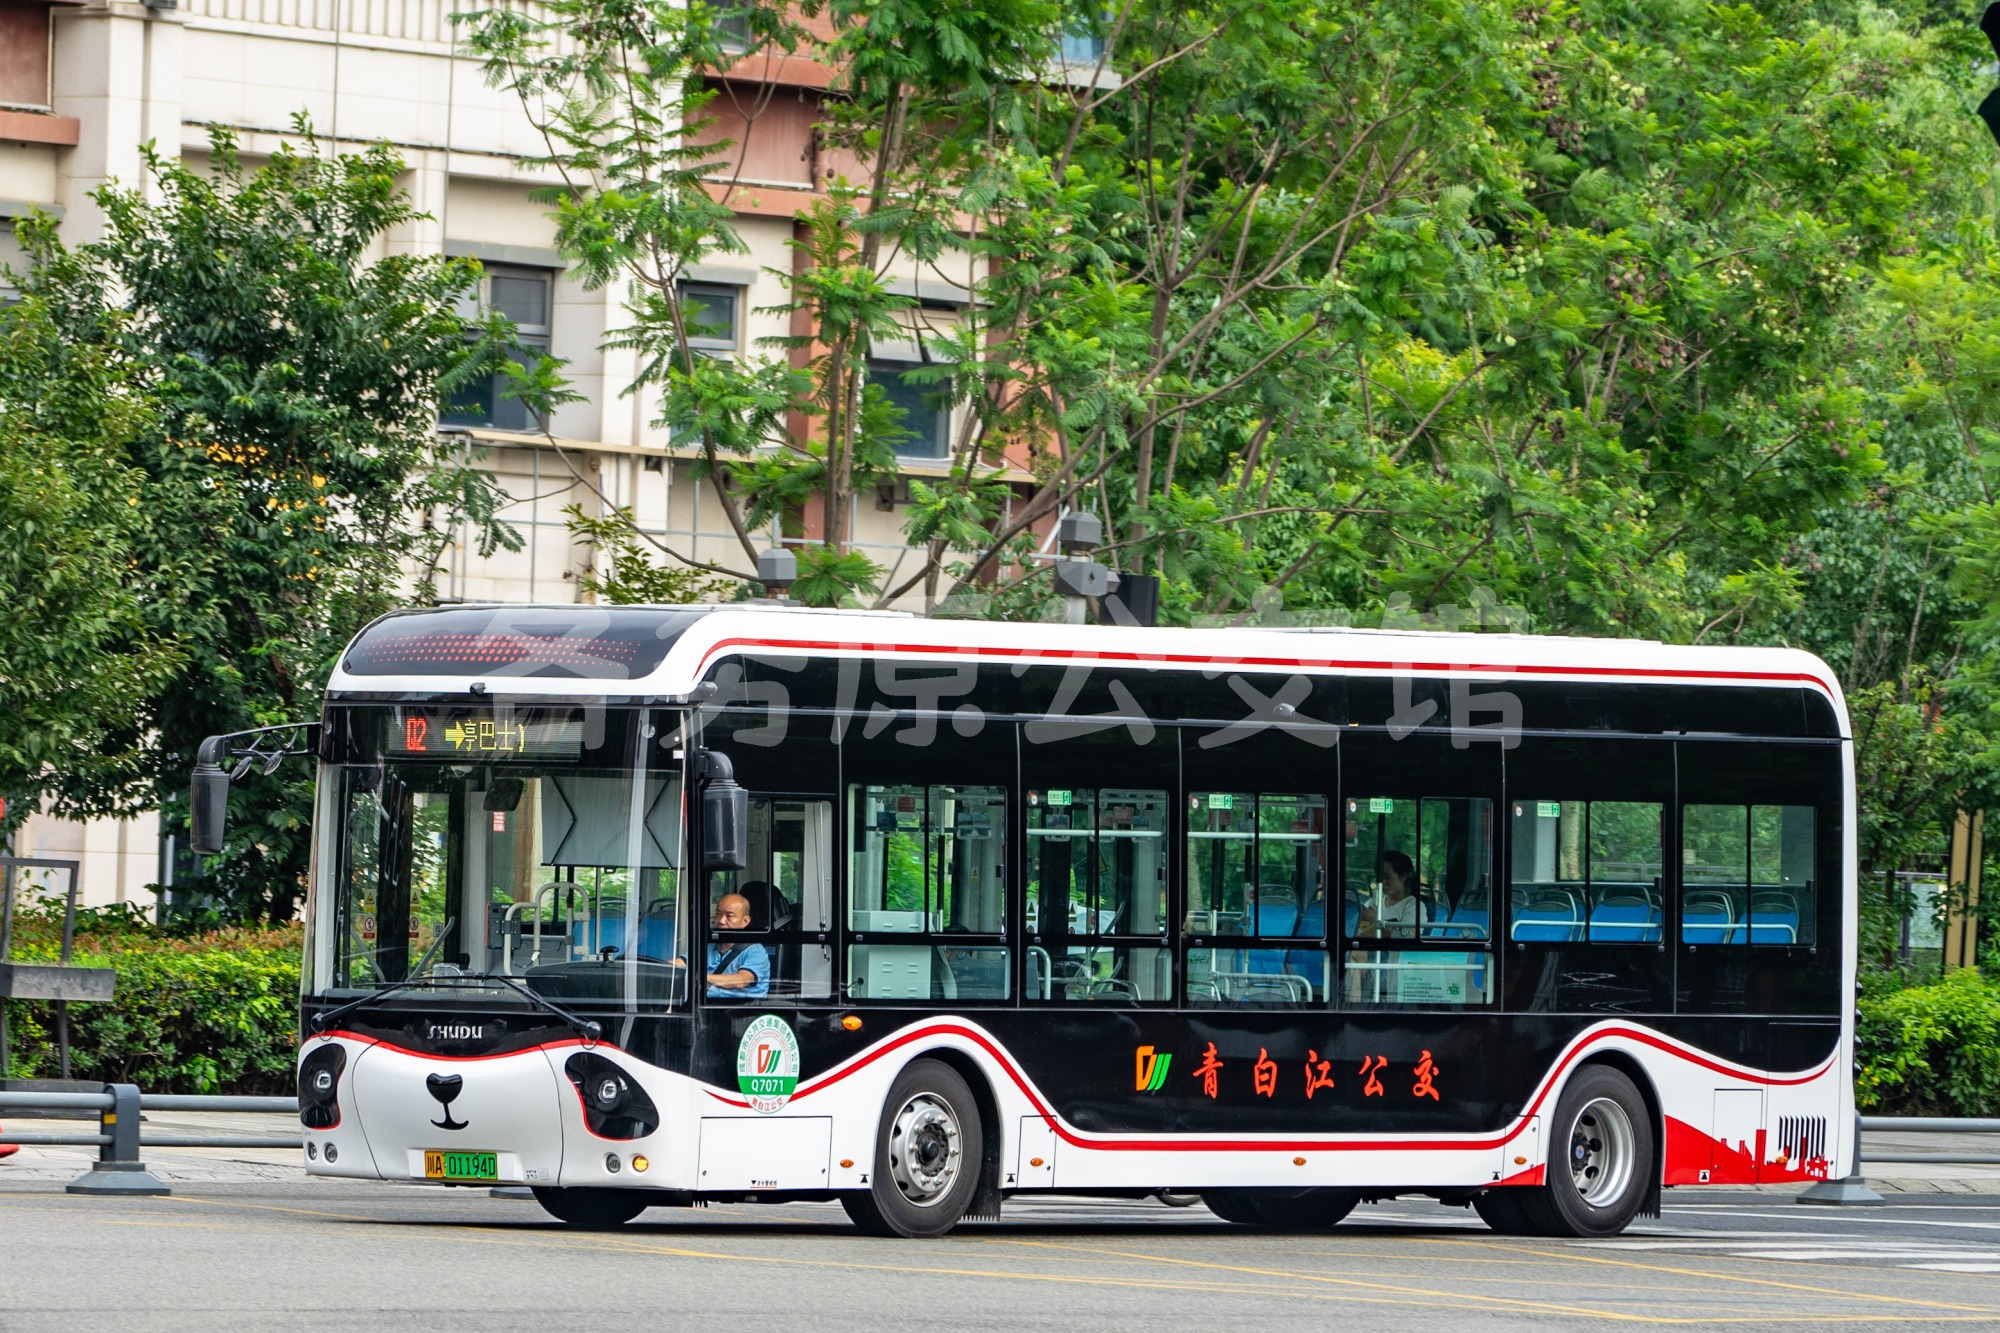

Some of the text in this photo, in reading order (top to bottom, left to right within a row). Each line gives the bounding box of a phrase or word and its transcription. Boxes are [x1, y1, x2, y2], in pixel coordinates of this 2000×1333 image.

[427, 1025, 483, 1039] SHUDU
[1192, 1042, 1440, 1101] 青白江公交
[751, 1079, 784, 1093] Q7071
[751, 1097, 784, 1112] 青白江公交
